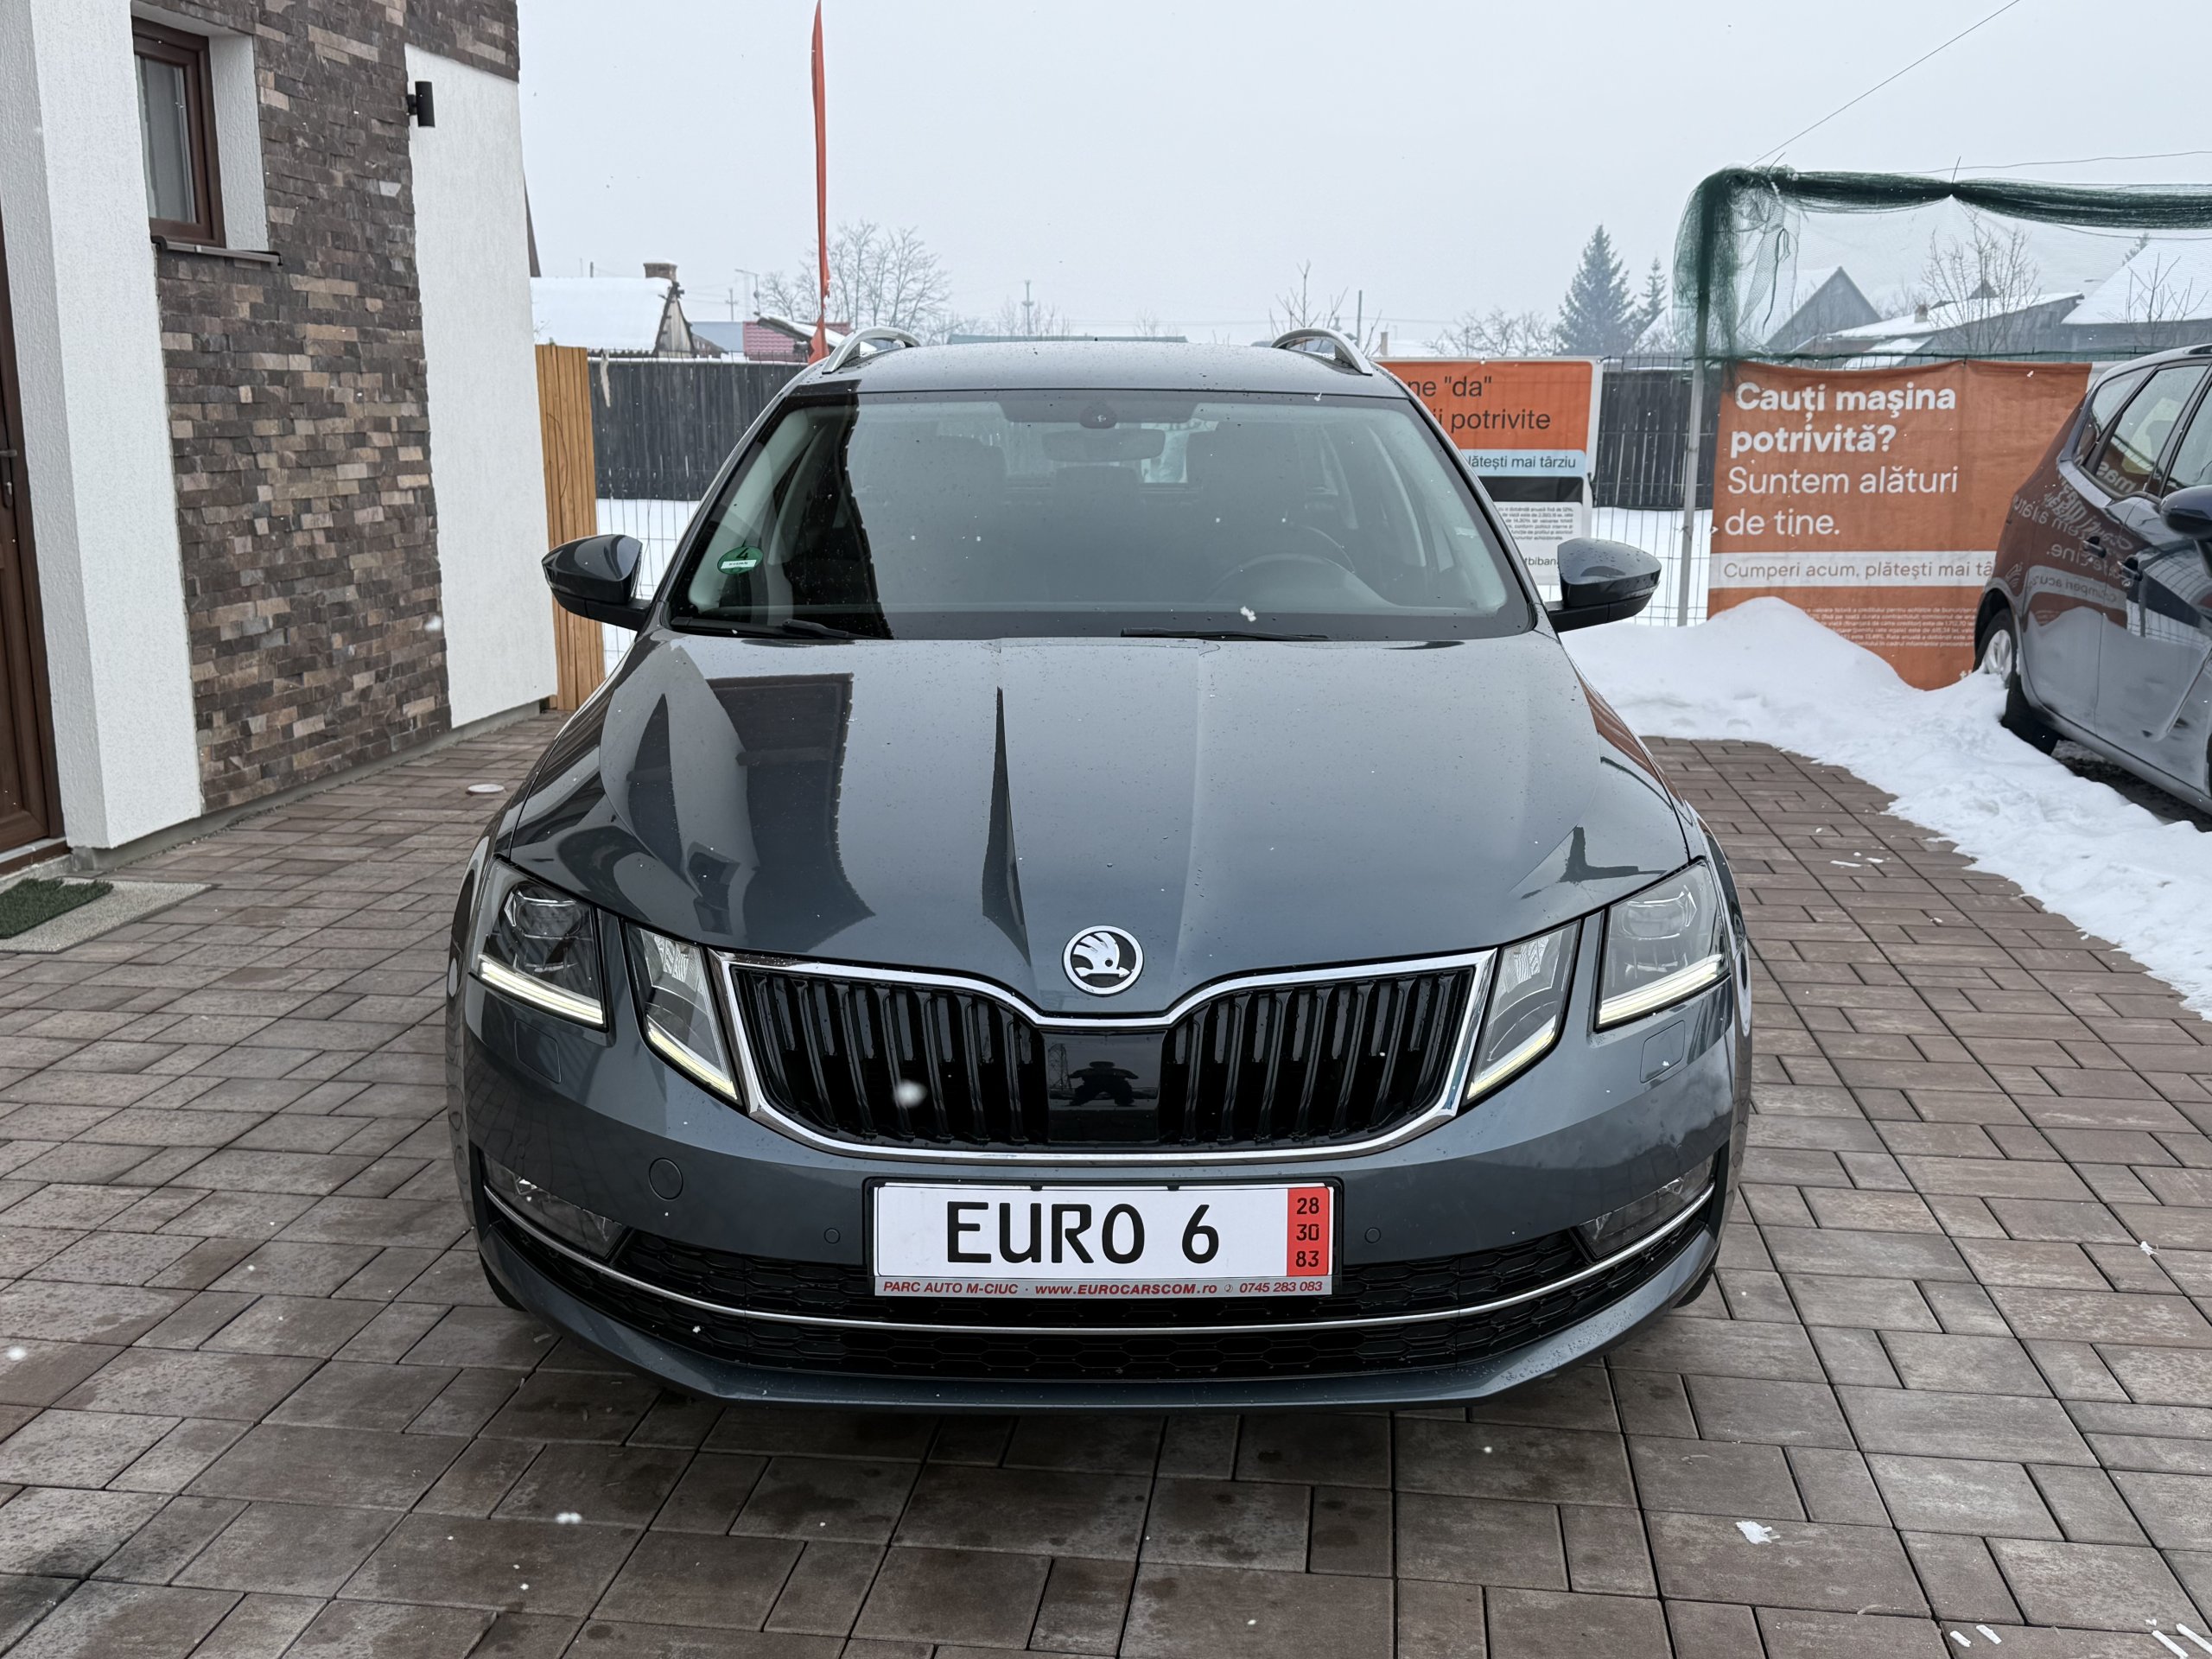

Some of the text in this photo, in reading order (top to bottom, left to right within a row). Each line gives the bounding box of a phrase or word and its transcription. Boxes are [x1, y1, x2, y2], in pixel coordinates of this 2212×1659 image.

[1444, 376, 1492, 397] "da"
[1735, 382, 1826, 422] Cauți
[1452, 409, 1551, 434] potrivite
[1730, 423, 1897, 459] potrivită?
[1512, 455, 1536, 467] mai
[1540, 455, 1576, 468] târziu
[1727, 466, 1959, 494] Suntem alături
[1725, 508, 1840, 536] de tine.
[735, 547, 749, 560] 4
[1724, 563, 1801, 580] Cumperi
[1937, 562, 1971, 577] mai
[1296, 1197, 1320, 1215] 28
[947, 1201, 1220, 1264] EURO 6
[1296, 1224, 1320, 1242] 30
[1295, 1250, 1320, 1268] 83
[883, 1281, 1323, 1295] PARC AUTO M-CIUC www.EUROCARSCOM.ro 0745 283 083
